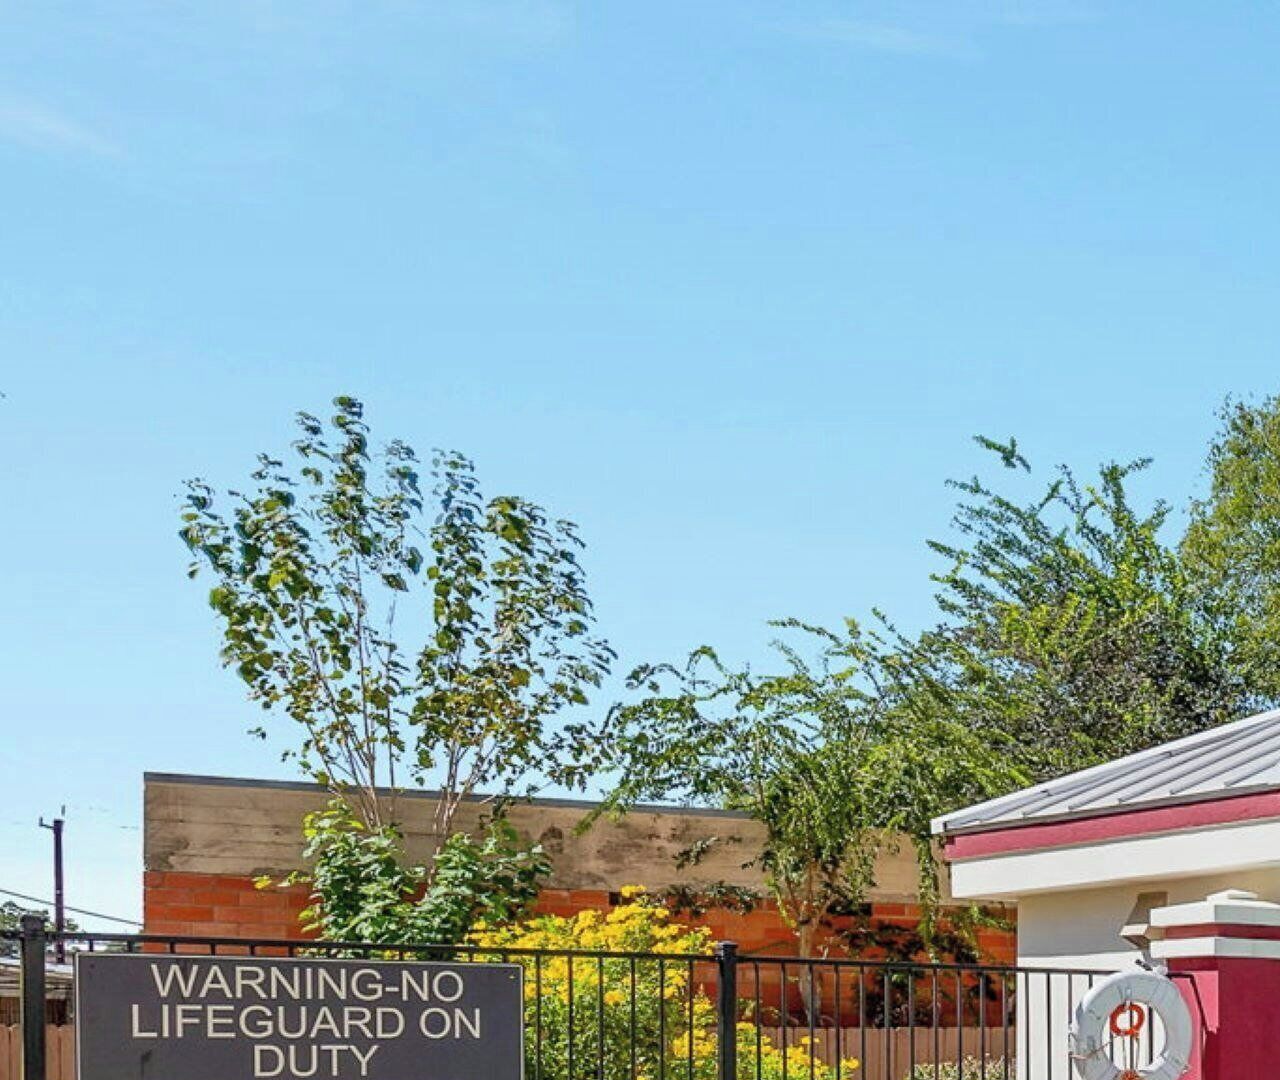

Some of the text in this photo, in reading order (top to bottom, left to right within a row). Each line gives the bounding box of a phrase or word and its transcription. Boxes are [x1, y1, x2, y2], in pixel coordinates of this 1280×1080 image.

[150, 963, 465, 1001] WARNING-NO
[131, 1004, 482, 1040] LIFEGUARD ON
[252, 1045, 380, 1079] DUTY
